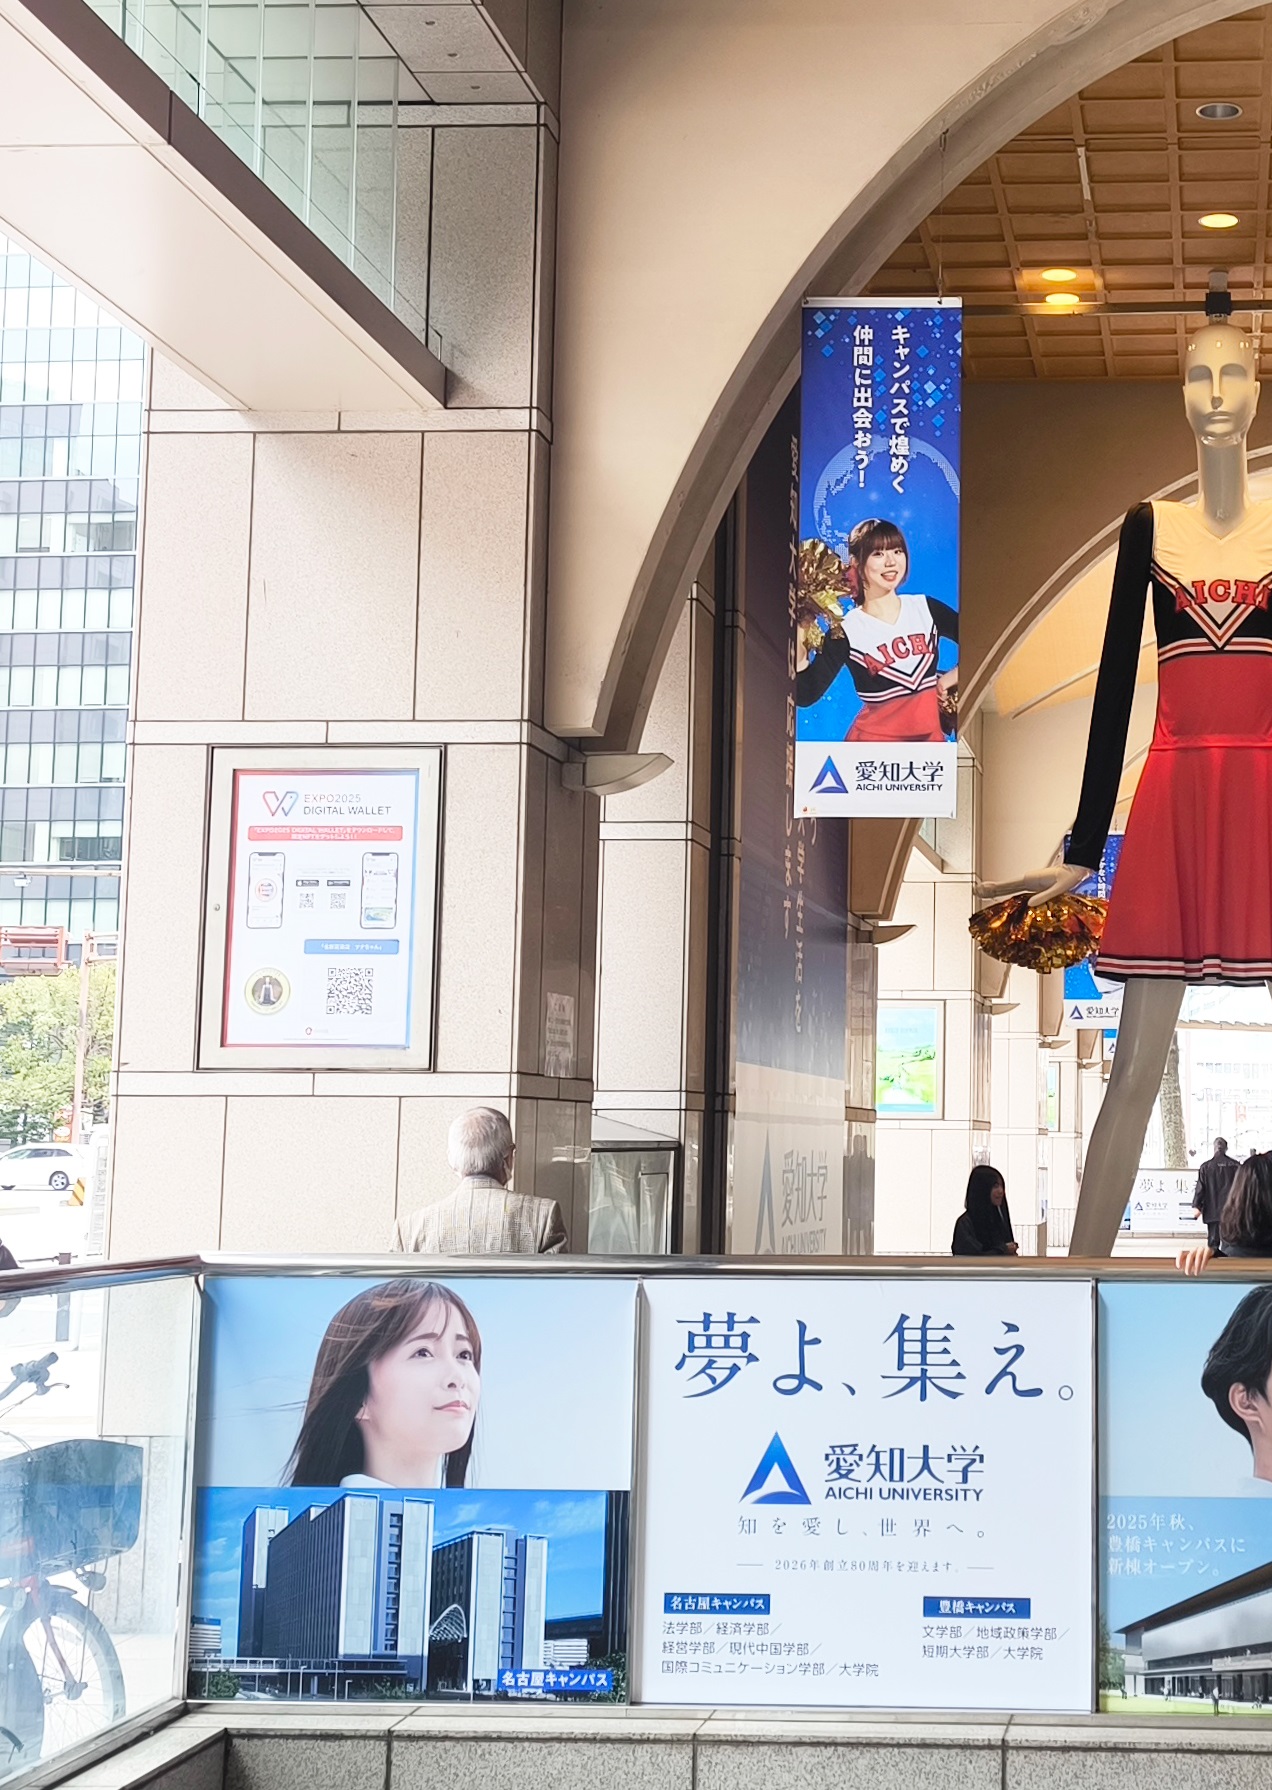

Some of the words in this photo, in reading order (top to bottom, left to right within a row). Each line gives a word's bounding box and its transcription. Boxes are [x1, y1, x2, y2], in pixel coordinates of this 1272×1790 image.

[852, 325, 874, 488] 仲間に出会おう！
[888, 325, 911, 494] キャンパスで煌めく
[1175, 579, 1272, 614] AICHI
[855, 760, 944, 783] 愛知大学
[856, 783, 883, 792] AICHI
[886, 783, 943, 792] UNIVERSITY
[304, 793, 361, 803] EXPO2025
[303, 806, 345, 816] DIGITAL
[348, 806, 391, 816] WALLET
[781, 1149, 828, 1227] 愛知大学
[675, 1312, 1074, 1402] 夢よ、集え。
[824, 1444, 985, 1484] 愛知大学
[824, 1487, 874, 1501] AICHI
[879, 1488, 984, 1502] UNIVERSITY
[738, 1516, 985, 1540] 知を愛し、世界へ。
[1107, 1512, 1195, 1531] 2025年秋、
[1107, 1536, 1246, 1553] 豊橋キャンパスに
[774, 1558, 960, 1574] 2026年創立80周年を迎えます。
[1107, 1557, 1220, 1577] 新棟オープン。
[670, 1596, 765, 1611] 名古屋キャンパス
[938, 1600, 1016, 1615] 豊橋キャンパス
[662, 1621, 783, 1636] 法学部／経済学部／
[921, 1625, 1070, 1641] 文学部／地域政策学部／
[662, 1640, 823, 1657] 経営学部／現代中国学部／
[921, 1645, 1044, 1660] 短期大学部／大学院
[661, 1660, 879, 1678] 国際コミュニケーション学部／大学院
[501, 1671, 608, 1687] 名古屋キャンパス
